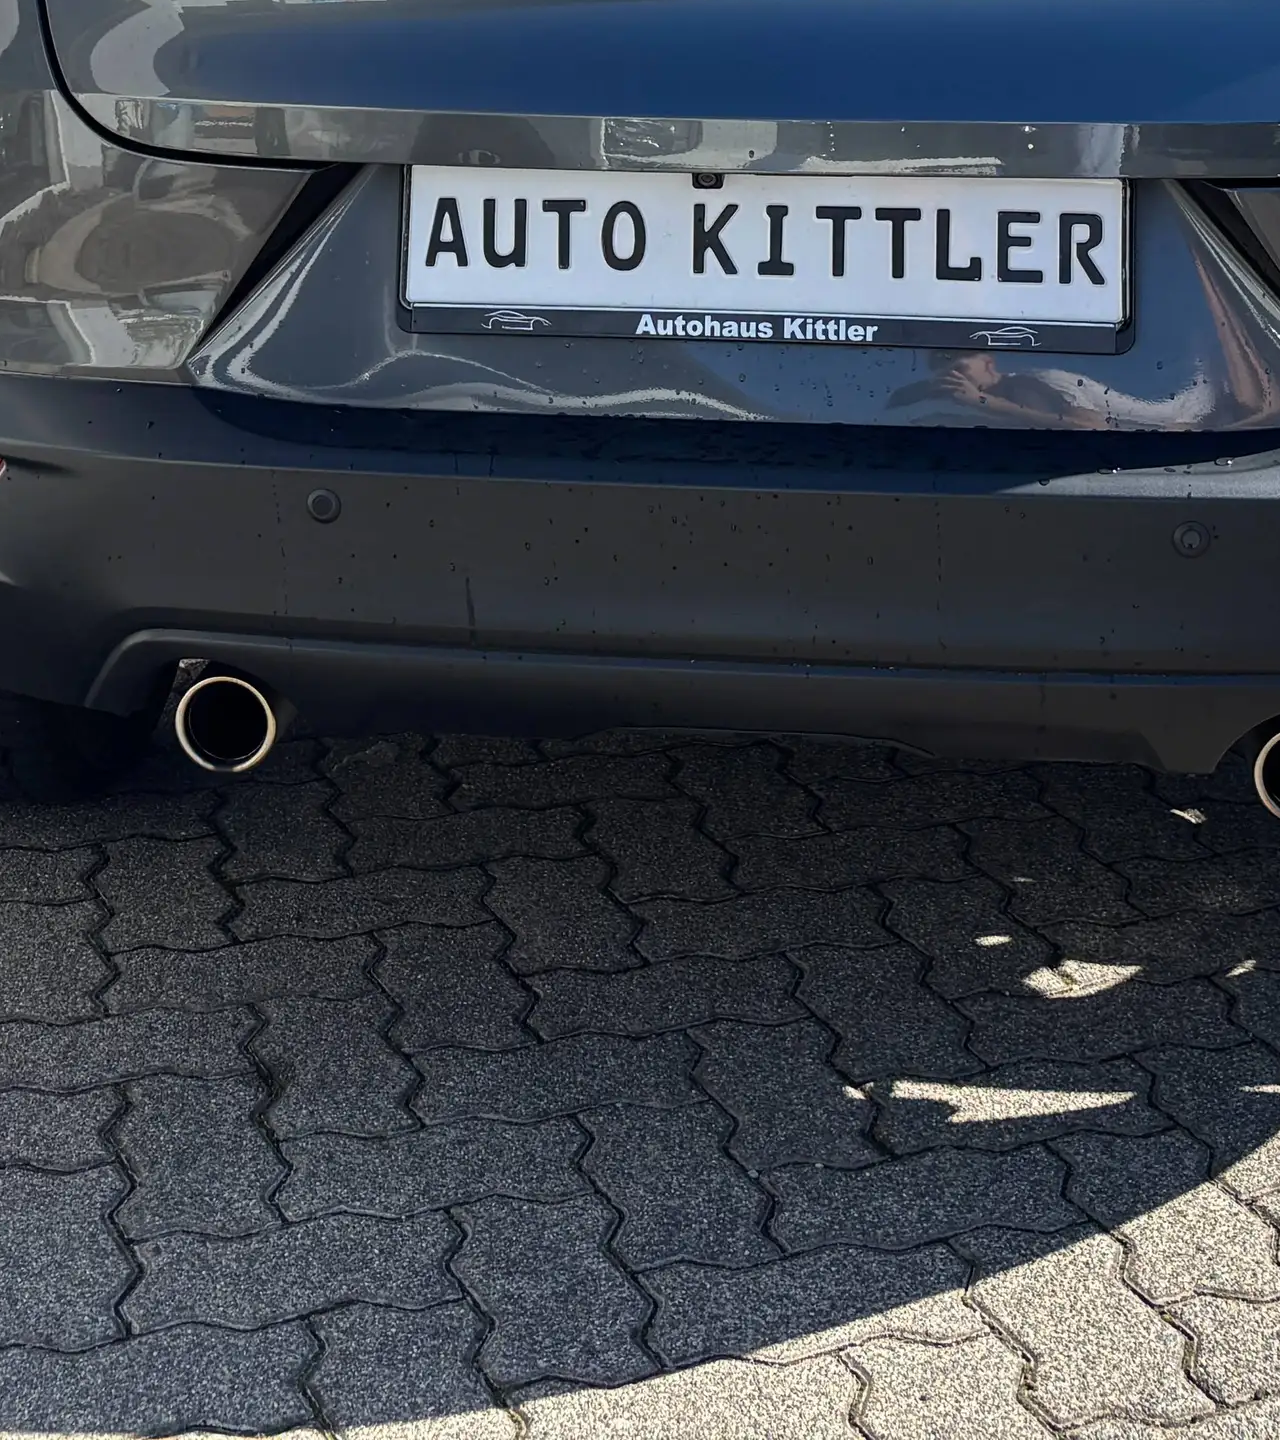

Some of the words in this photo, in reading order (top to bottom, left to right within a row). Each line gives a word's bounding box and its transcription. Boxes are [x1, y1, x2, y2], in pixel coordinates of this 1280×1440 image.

[424, 196, 647, 271] AUTO
[692, 203, 1106, 286] KITTLER
[635, 313, 774, 339] Autohaus
[782, 317, 878, 342] Kittler
